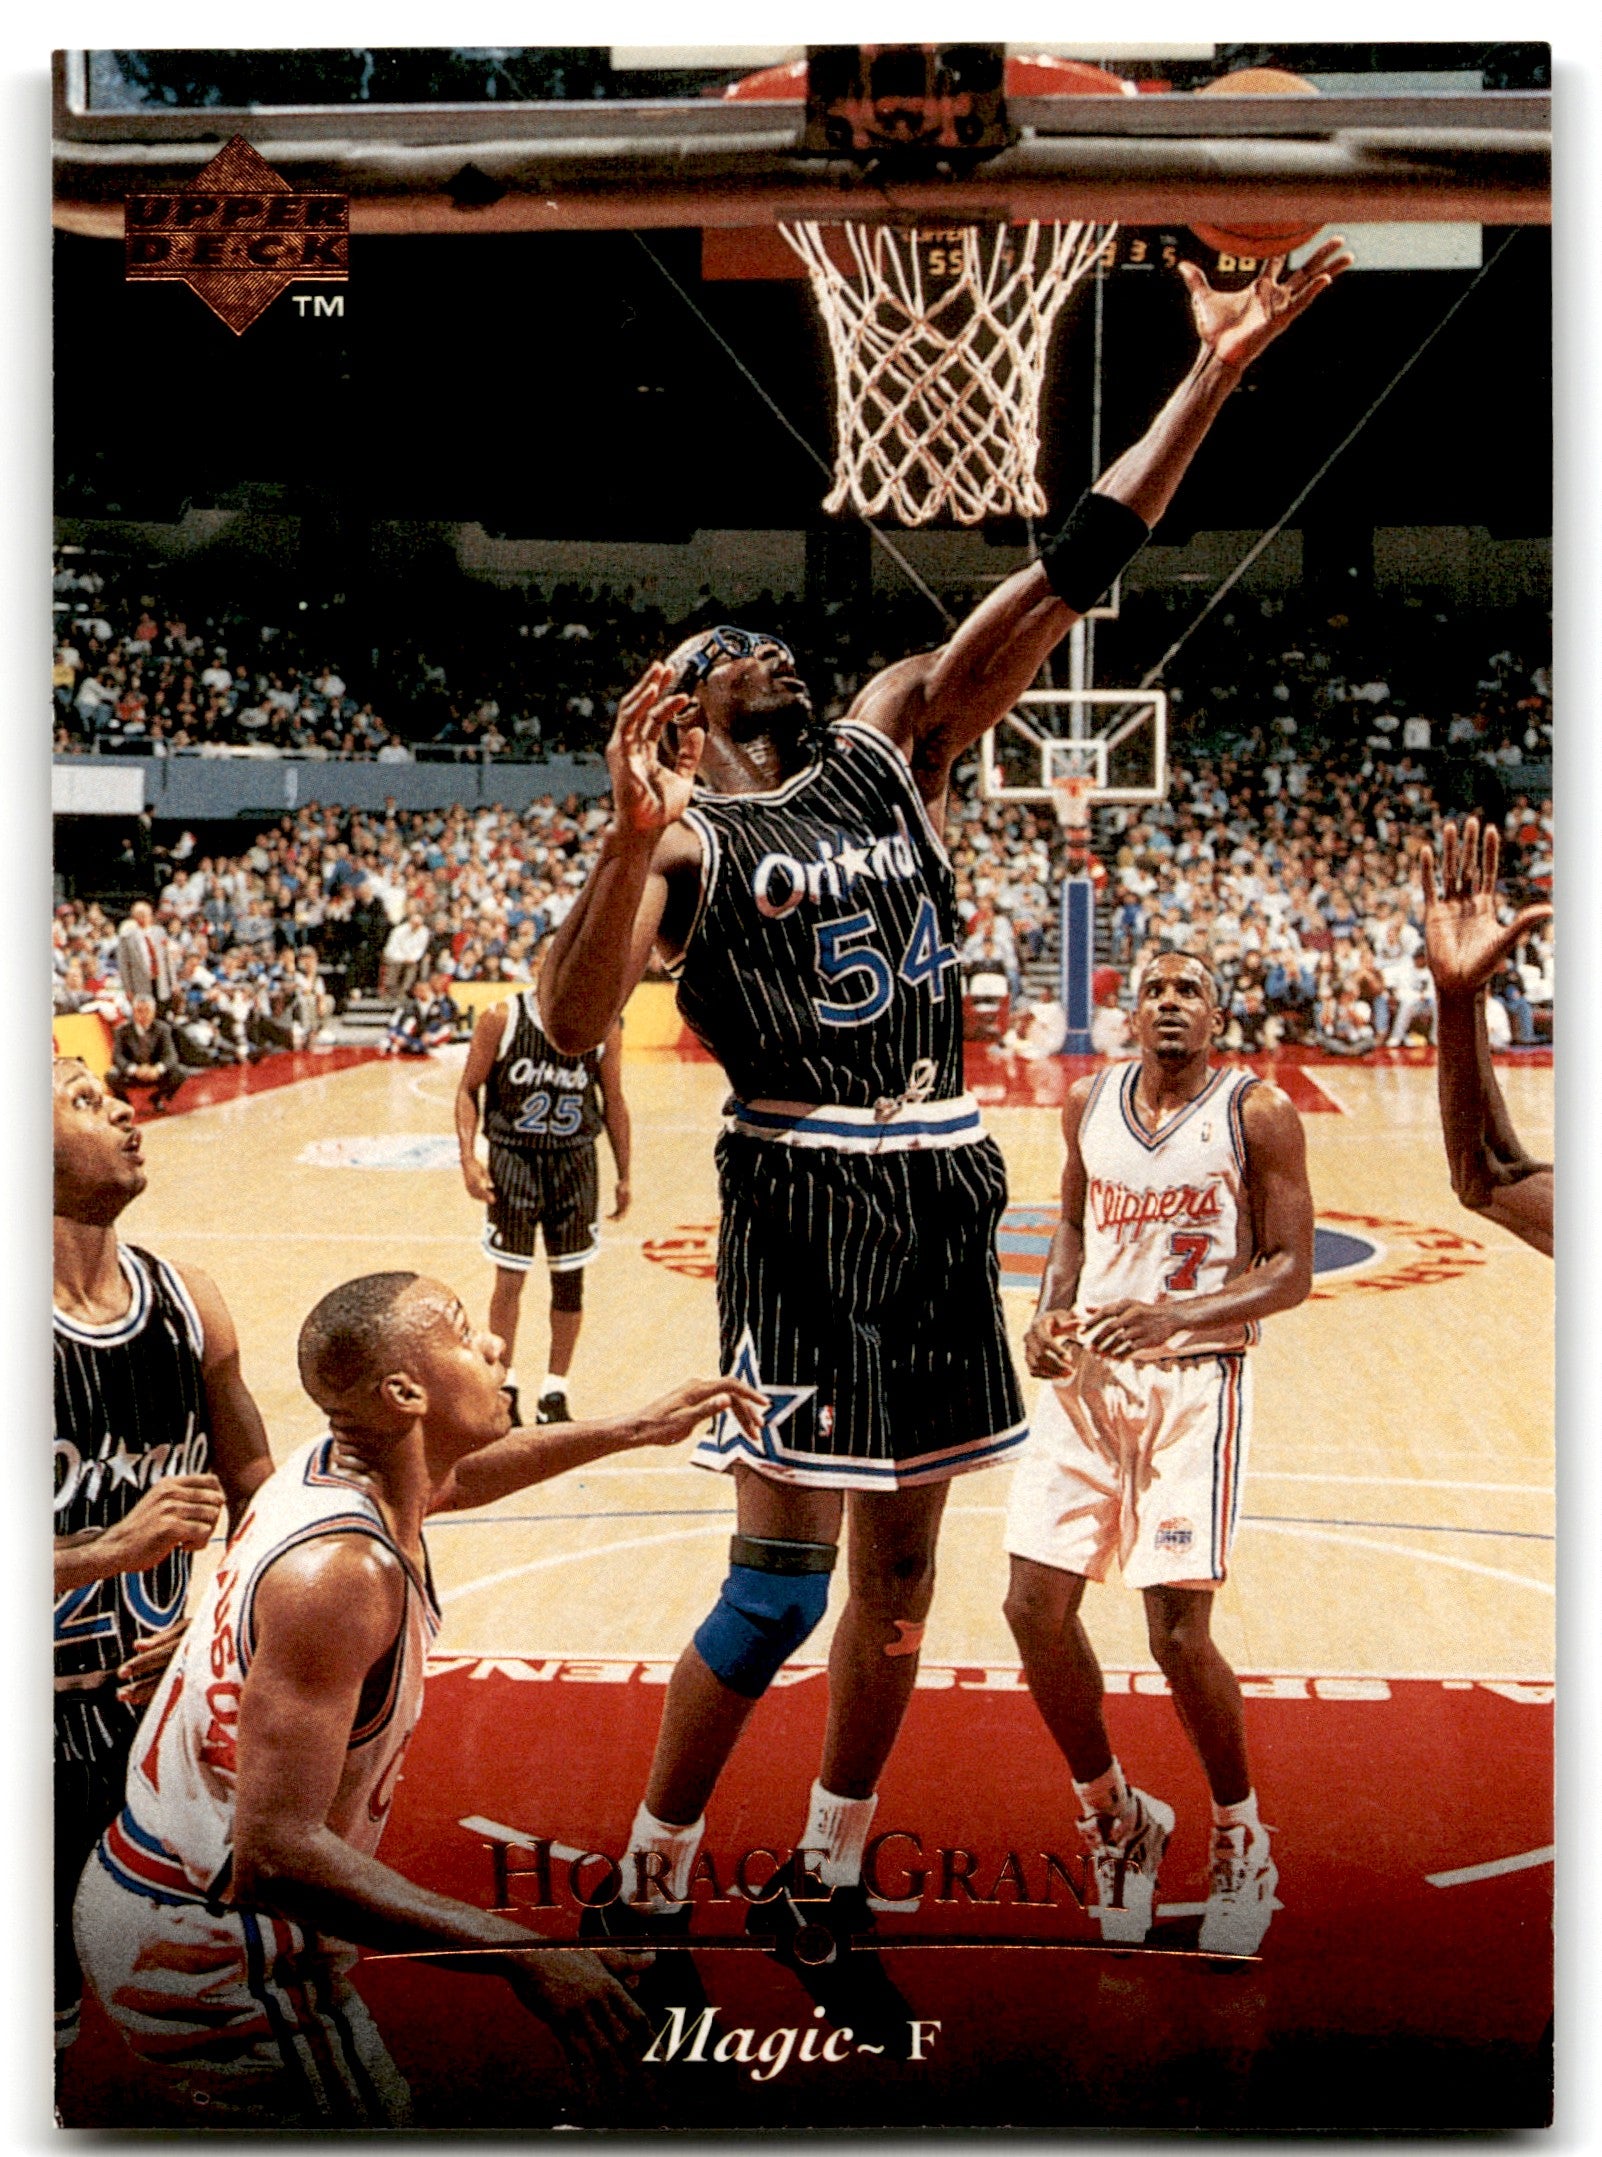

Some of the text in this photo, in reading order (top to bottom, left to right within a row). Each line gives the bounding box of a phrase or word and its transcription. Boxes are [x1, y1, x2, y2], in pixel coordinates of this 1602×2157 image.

[127, 196, 347, 228] UPPER
[292, 295, 345, 317] TM
[812, 892, 961, 1027] 54
[514, 1091, 584, 1136] 25
[1089, 1179, 1223, 1243] Clippers
[1165, 1231, 1213, 1291] 7
[485, 1832, 1143, 1912] HORACE GRANT
[906, 2020, 942, 2061] F
